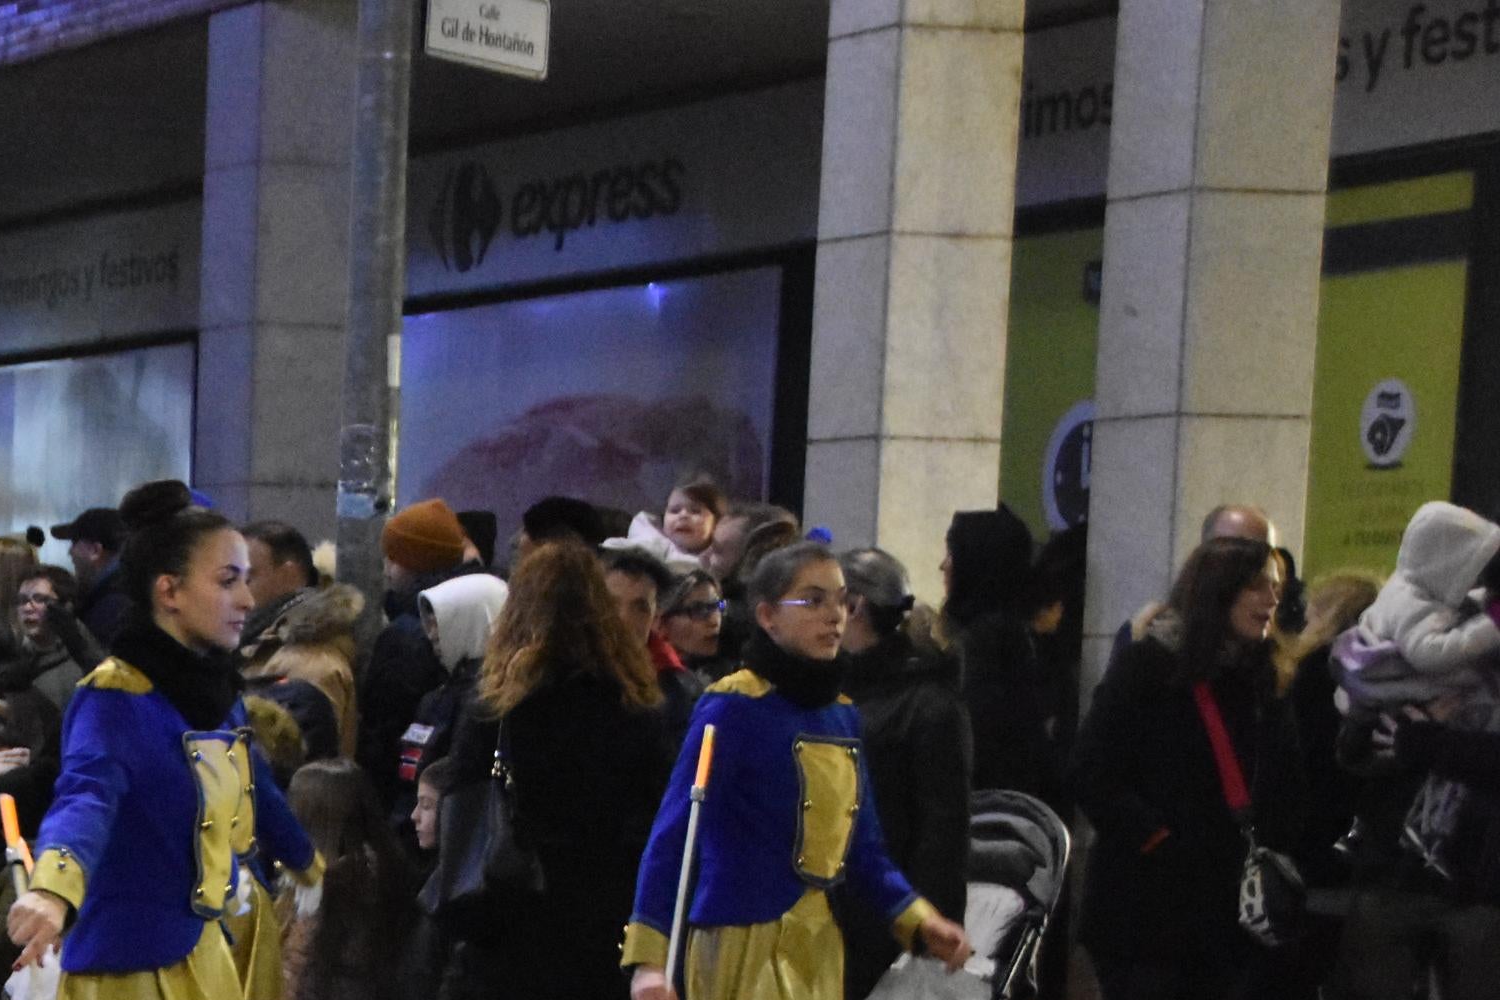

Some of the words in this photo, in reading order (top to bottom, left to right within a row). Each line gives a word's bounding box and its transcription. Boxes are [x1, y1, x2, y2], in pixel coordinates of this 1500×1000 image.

[441, 17, 459, 40] Gil
[462, 24, 476, 43] de
[1363, 28, 1390, 93] y
[510, 159, 685, 251] express
